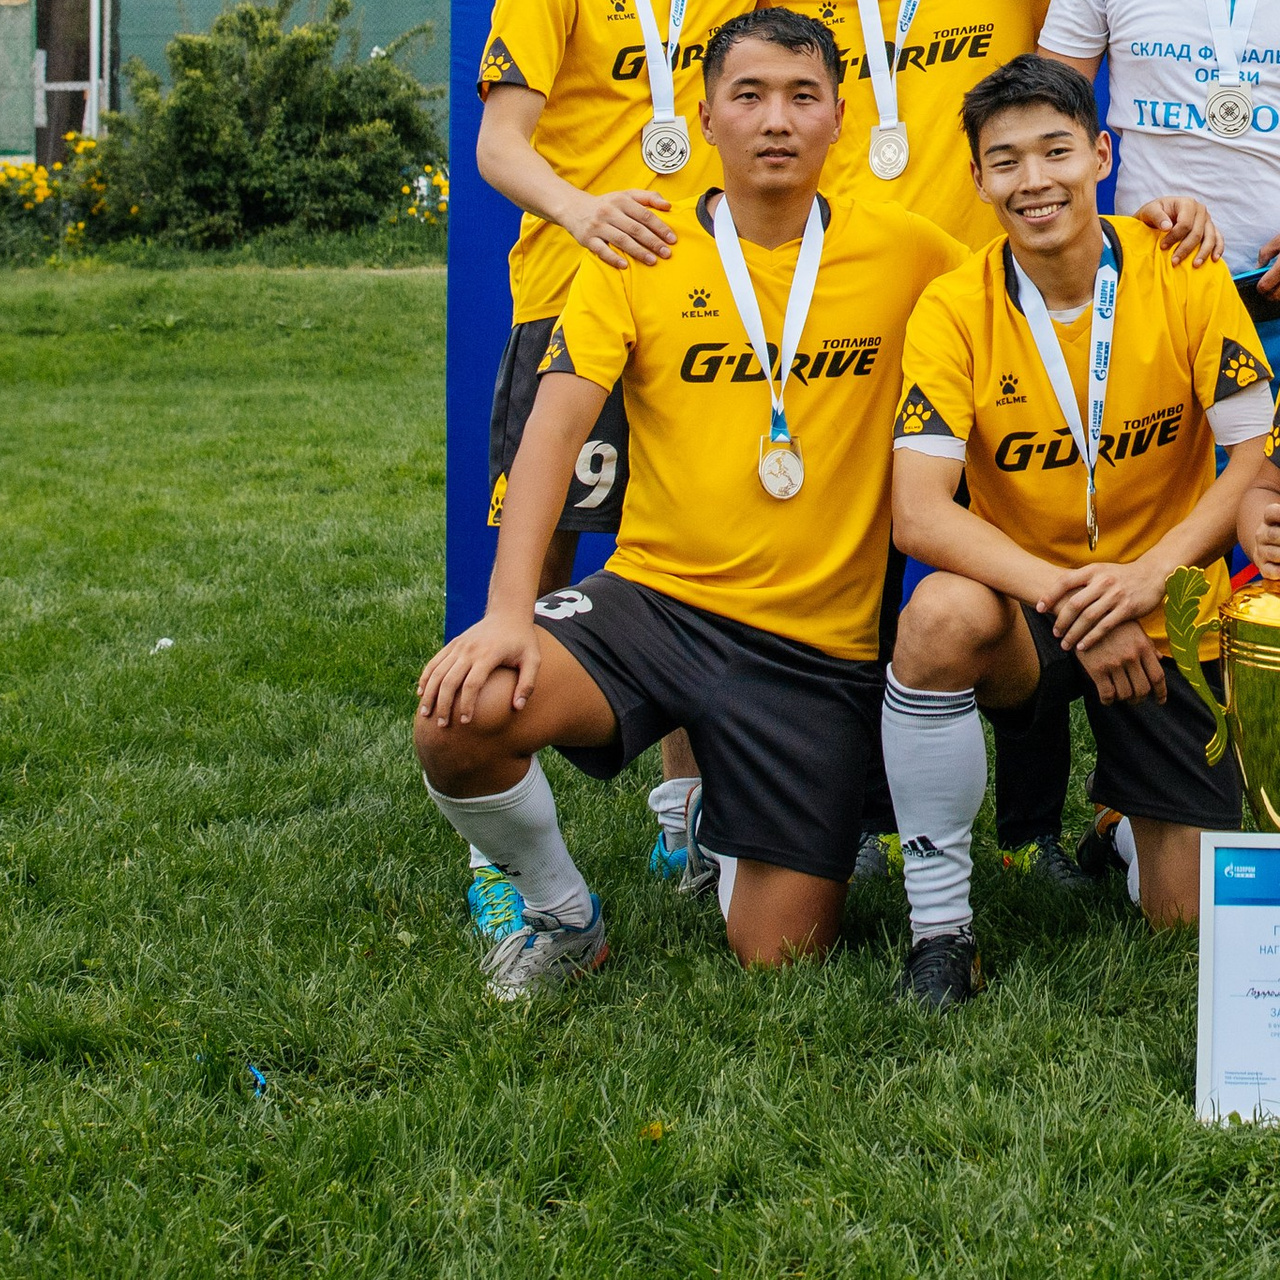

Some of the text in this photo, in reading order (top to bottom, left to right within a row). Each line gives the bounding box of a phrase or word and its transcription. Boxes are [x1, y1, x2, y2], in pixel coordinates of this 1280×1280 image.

[607, 13, 636, 21] KELME
[933, 23, 995, 40] ТОПЛИВО
[1131, 42, 1191, 62] СКЛАД
[1195, 68, 1260, 86] ОБВИ
[681, 309, 720, 319] KELME
[822, 336, 882, 350] ТОПЛИВО
[995, 395, 1027, 407] KELME
[1123, 403, 1184, 430] ТОПЛИВО
[574, 440, 618, 509] 9
